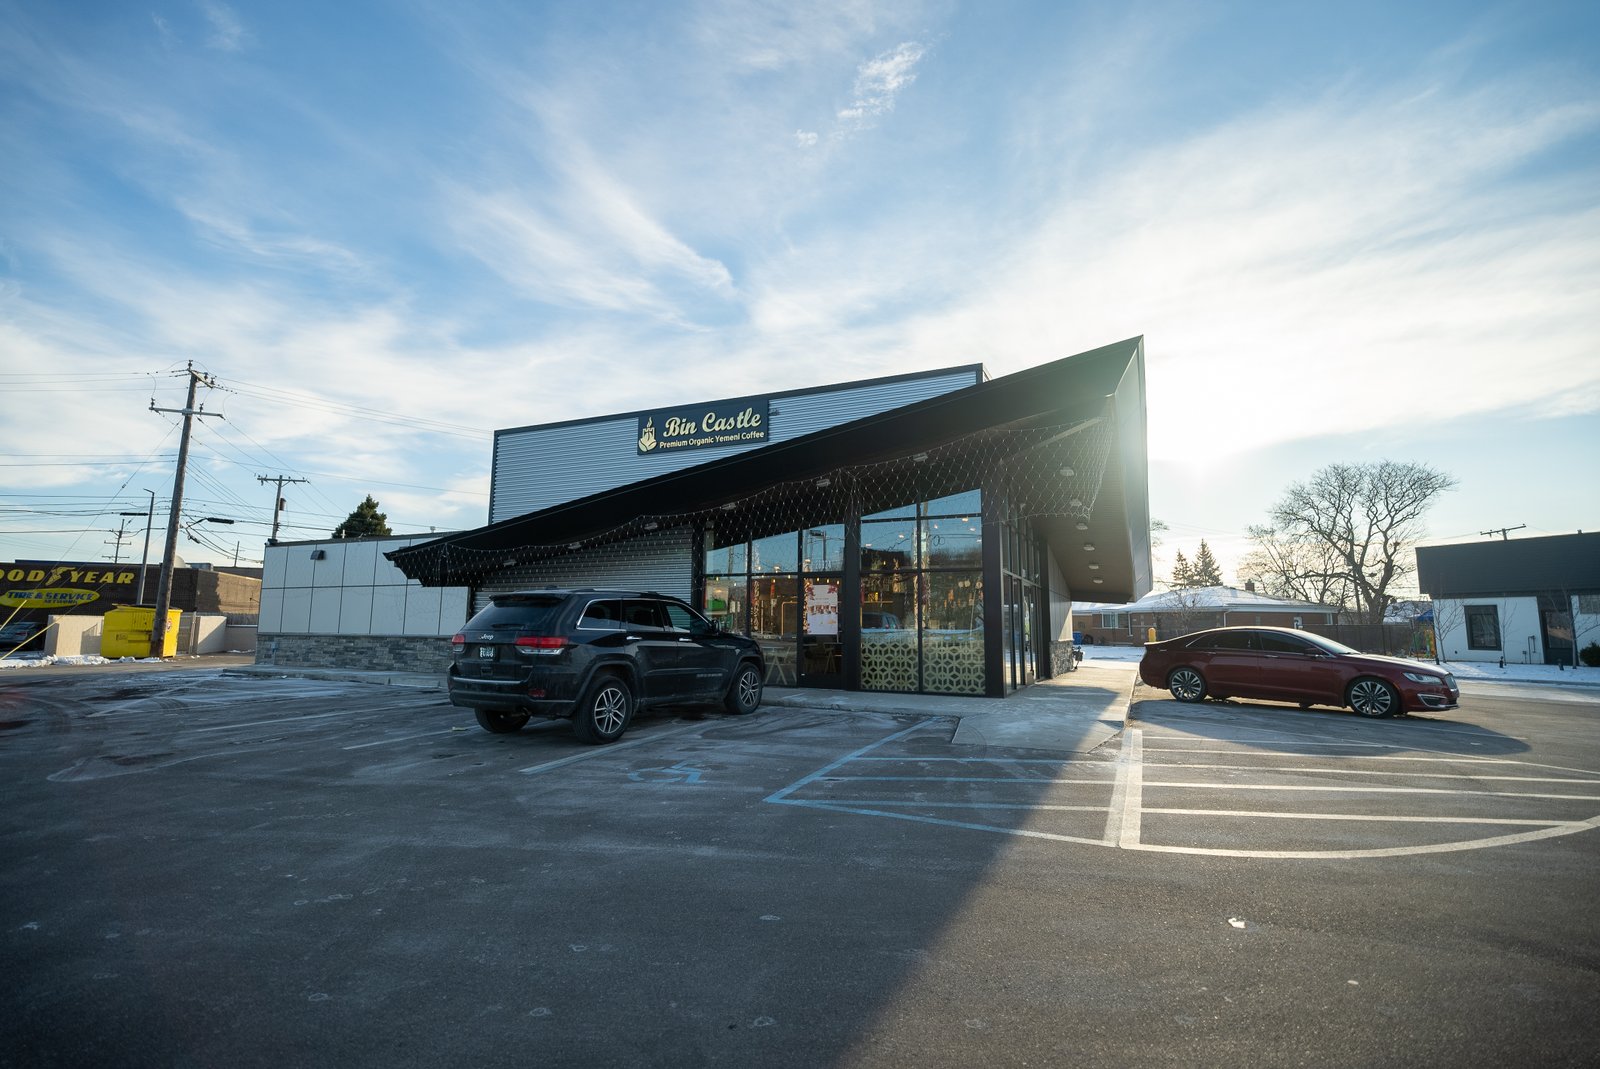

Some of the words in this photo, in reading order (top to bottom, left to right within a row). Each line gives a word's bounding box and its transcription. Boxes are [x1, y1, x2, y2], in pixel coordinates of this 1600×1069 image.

[663, 417, 697, 437] Bin
[702, 407, 761, 432] Castle
[660, 440, 688, 449] Premium
[689, 436, 714, 446] Organic
[715, 433, 740, 442] Yemeni
[741, 430, 765, 440] Coffee
[7, 591, 33, 599] TIRE
[46, 592, 96, 601] SERVICE
